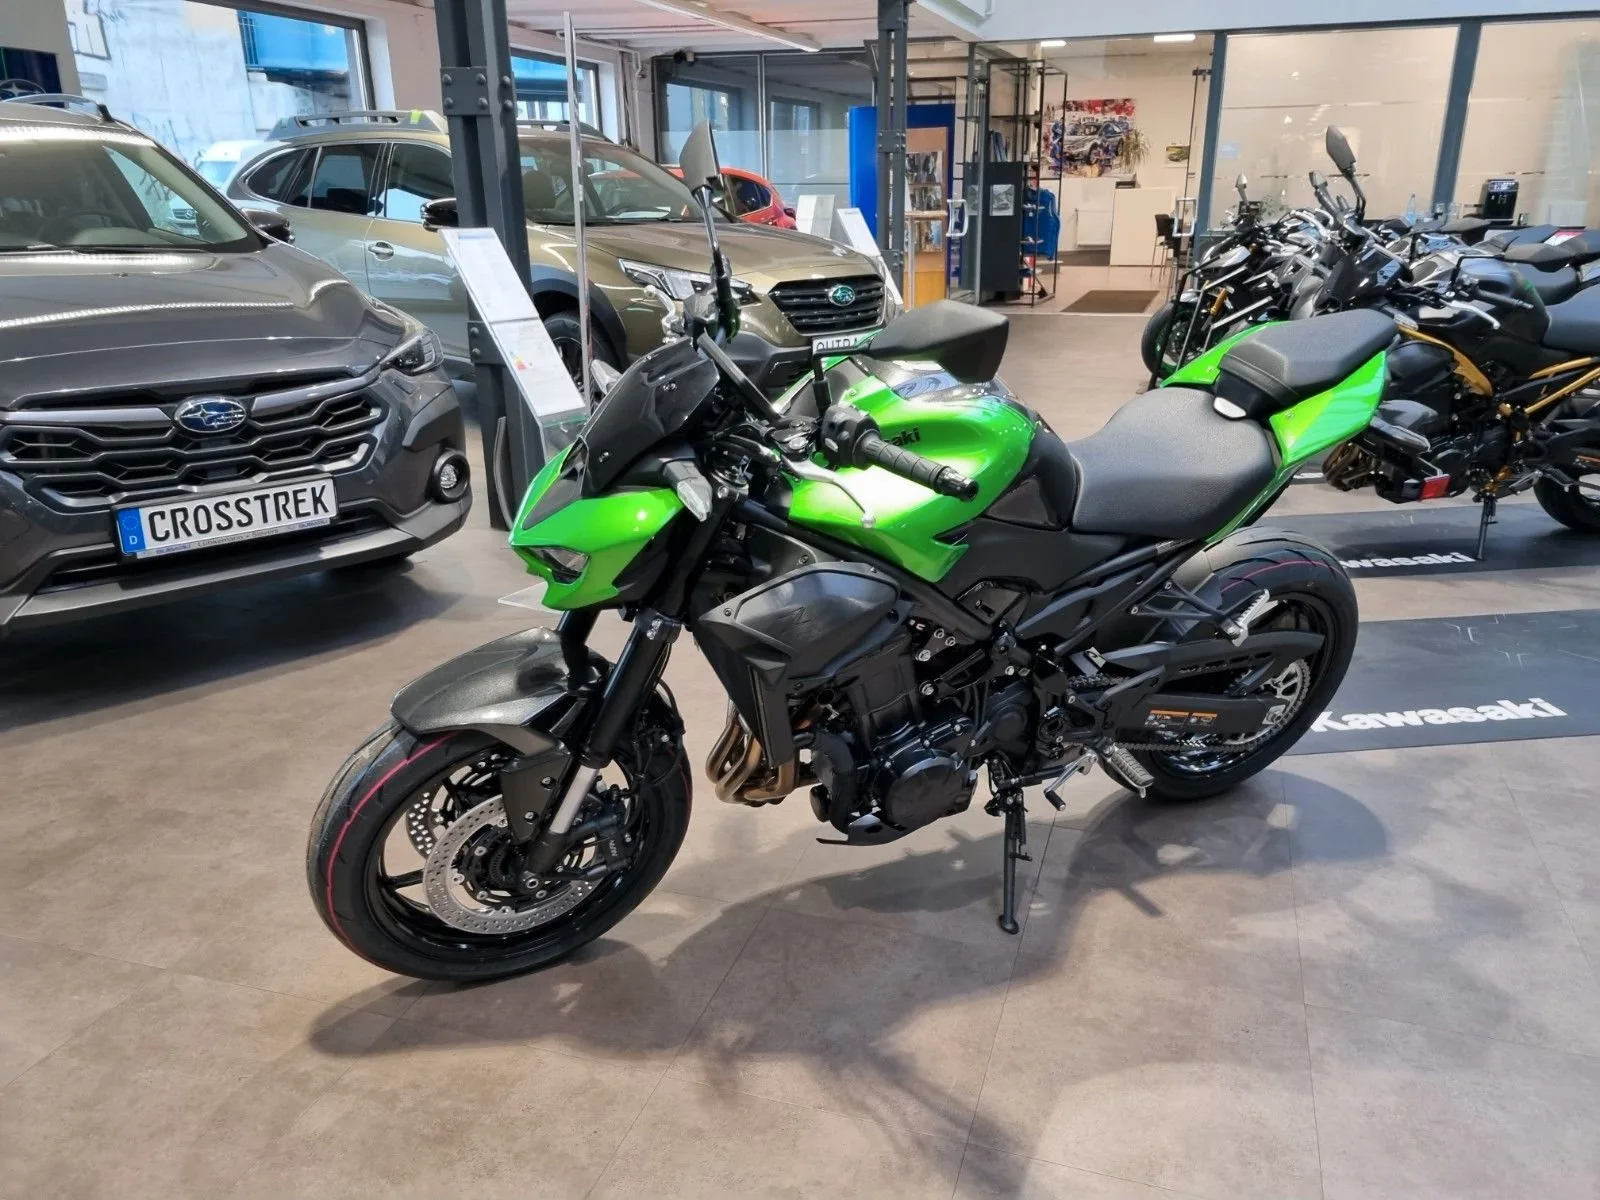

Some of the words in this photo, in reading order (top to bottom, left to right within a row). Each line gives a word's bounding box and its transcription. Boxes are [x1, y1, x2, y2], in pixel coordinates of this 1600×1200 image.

[148, 484, 329, 542] CROSSTREK
[129, 535, 138, 545] D
[1310, 697, 1568, 733] Kawasaki
